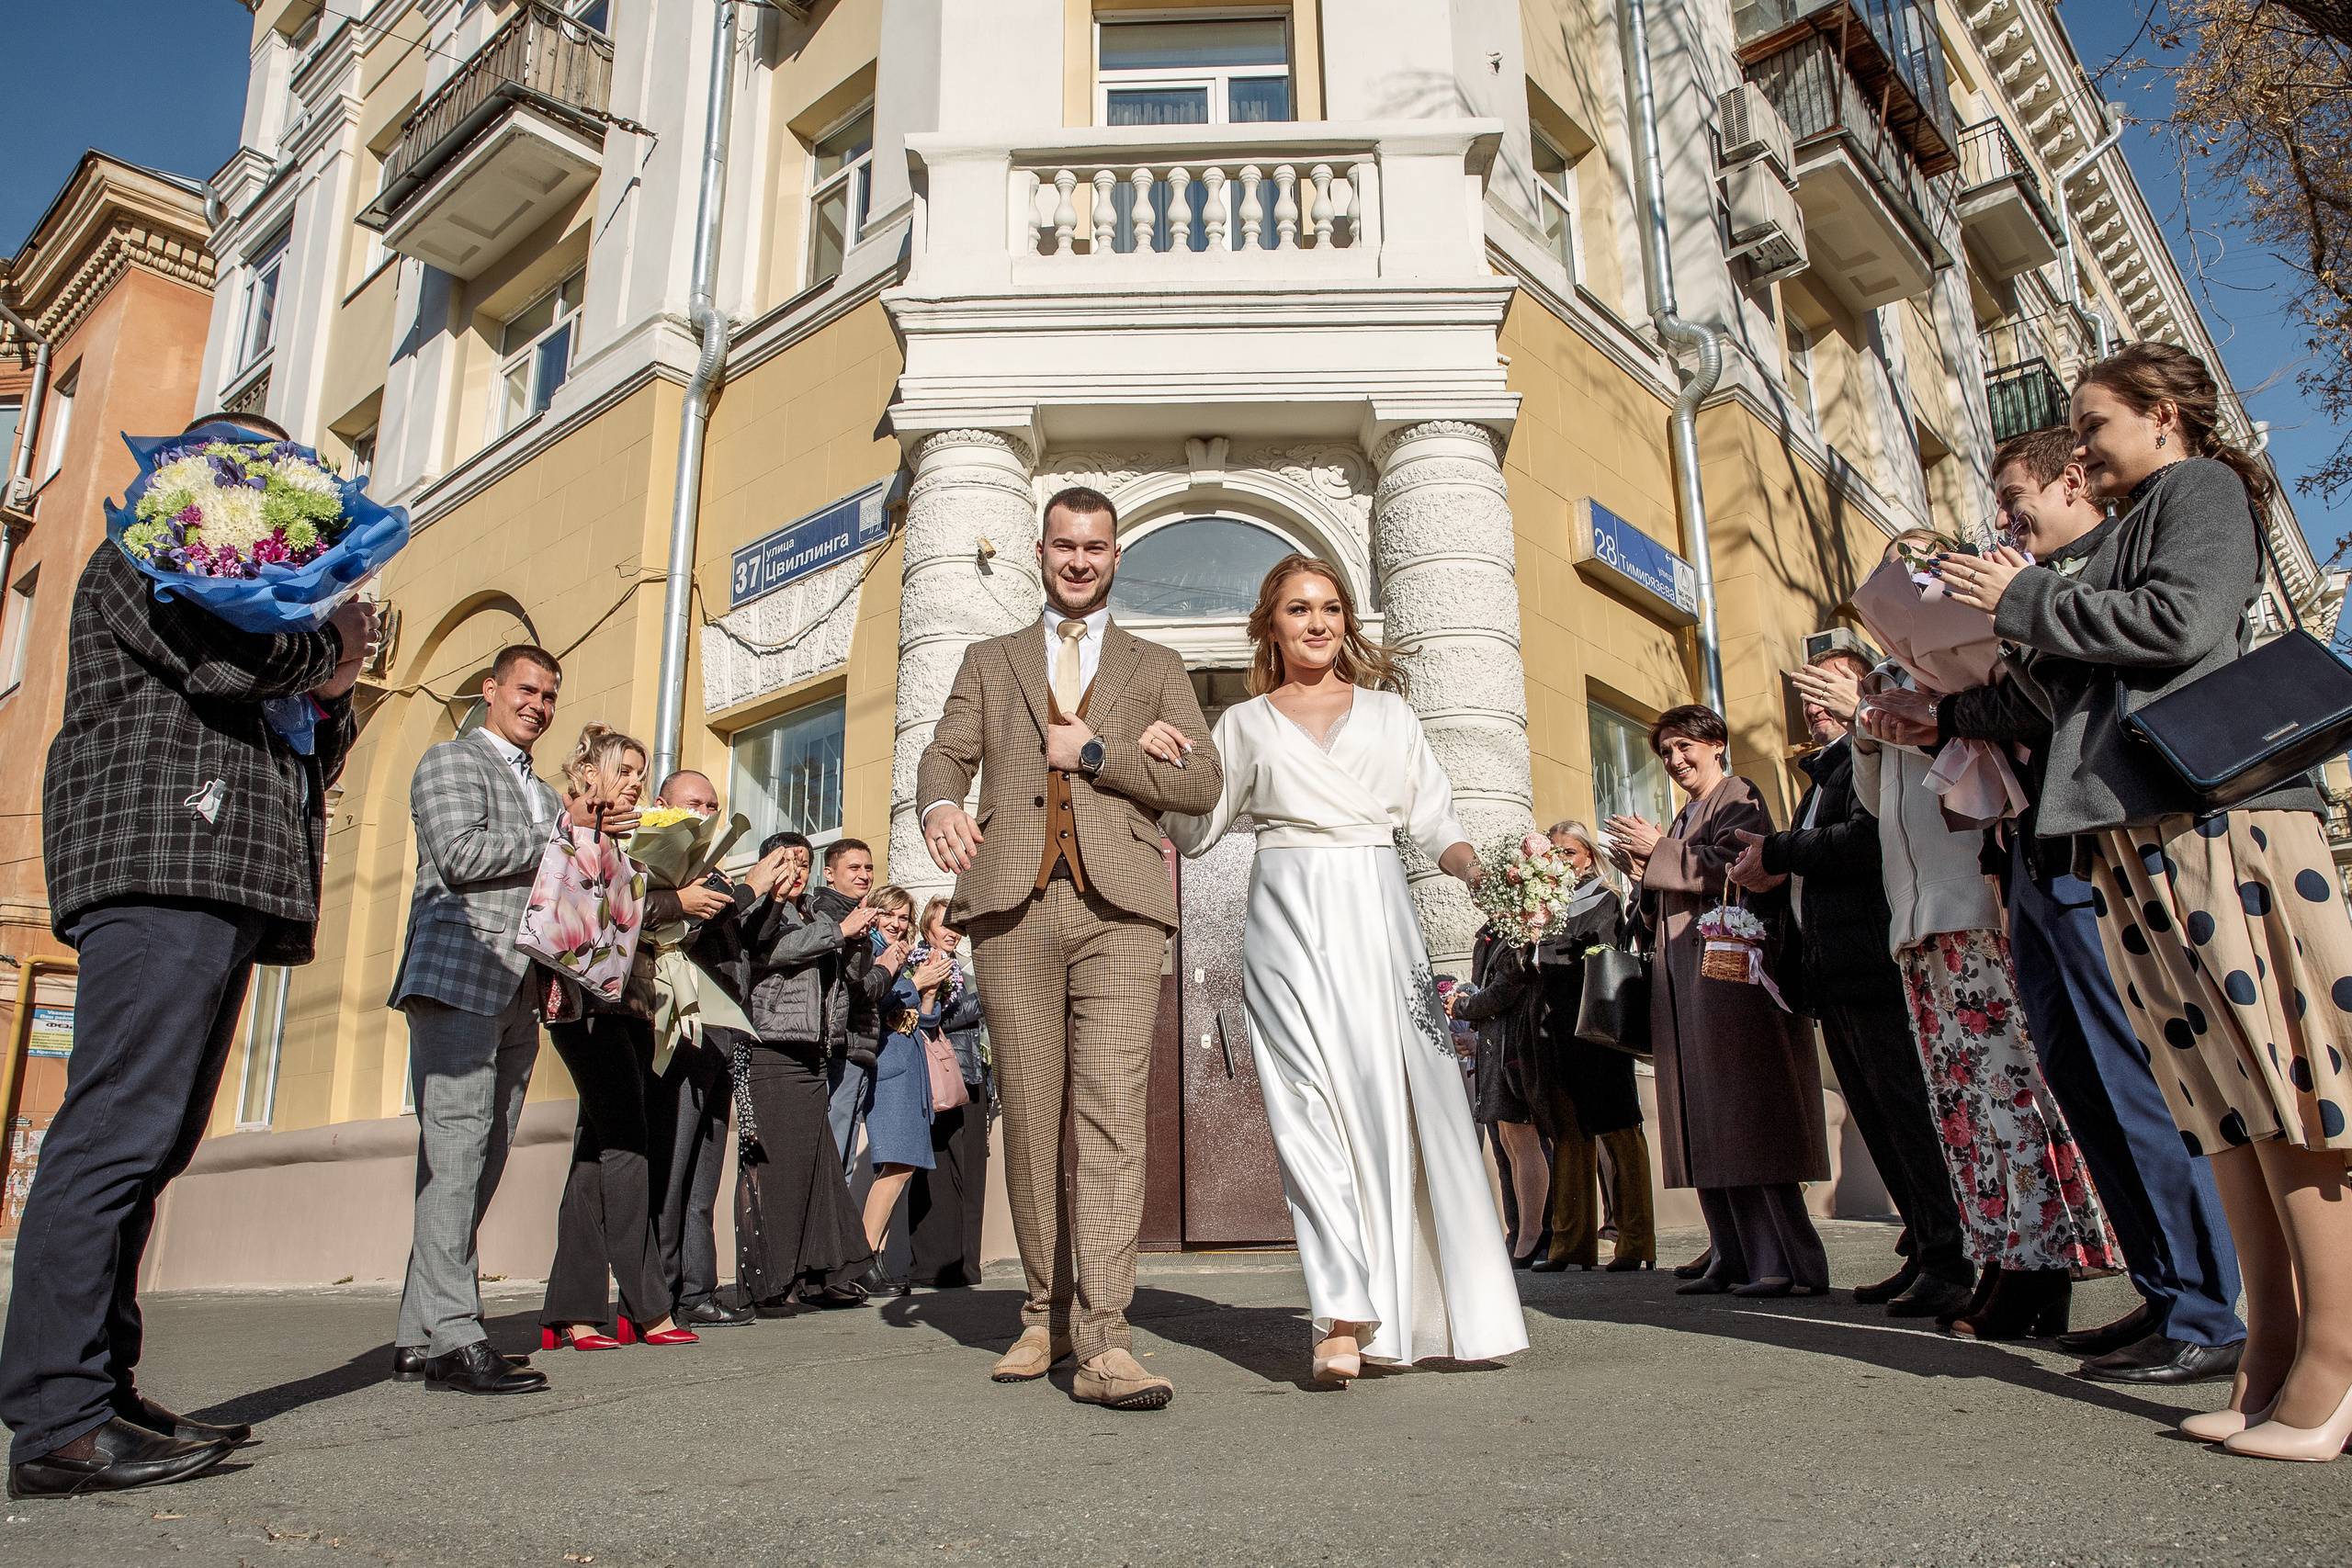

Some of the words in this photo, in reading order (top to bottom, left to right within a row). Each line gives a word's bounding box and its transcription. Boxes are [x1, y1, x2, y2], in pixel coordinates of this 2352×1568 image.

[765, 538, 795, 562] улица
[765, 533, 849, 582] Цвиллинга
[1594, 527, 1617, 566] 28
[735, 554, 761, 594] 37
[1619, 553, 1676, 602] Тимирязева
